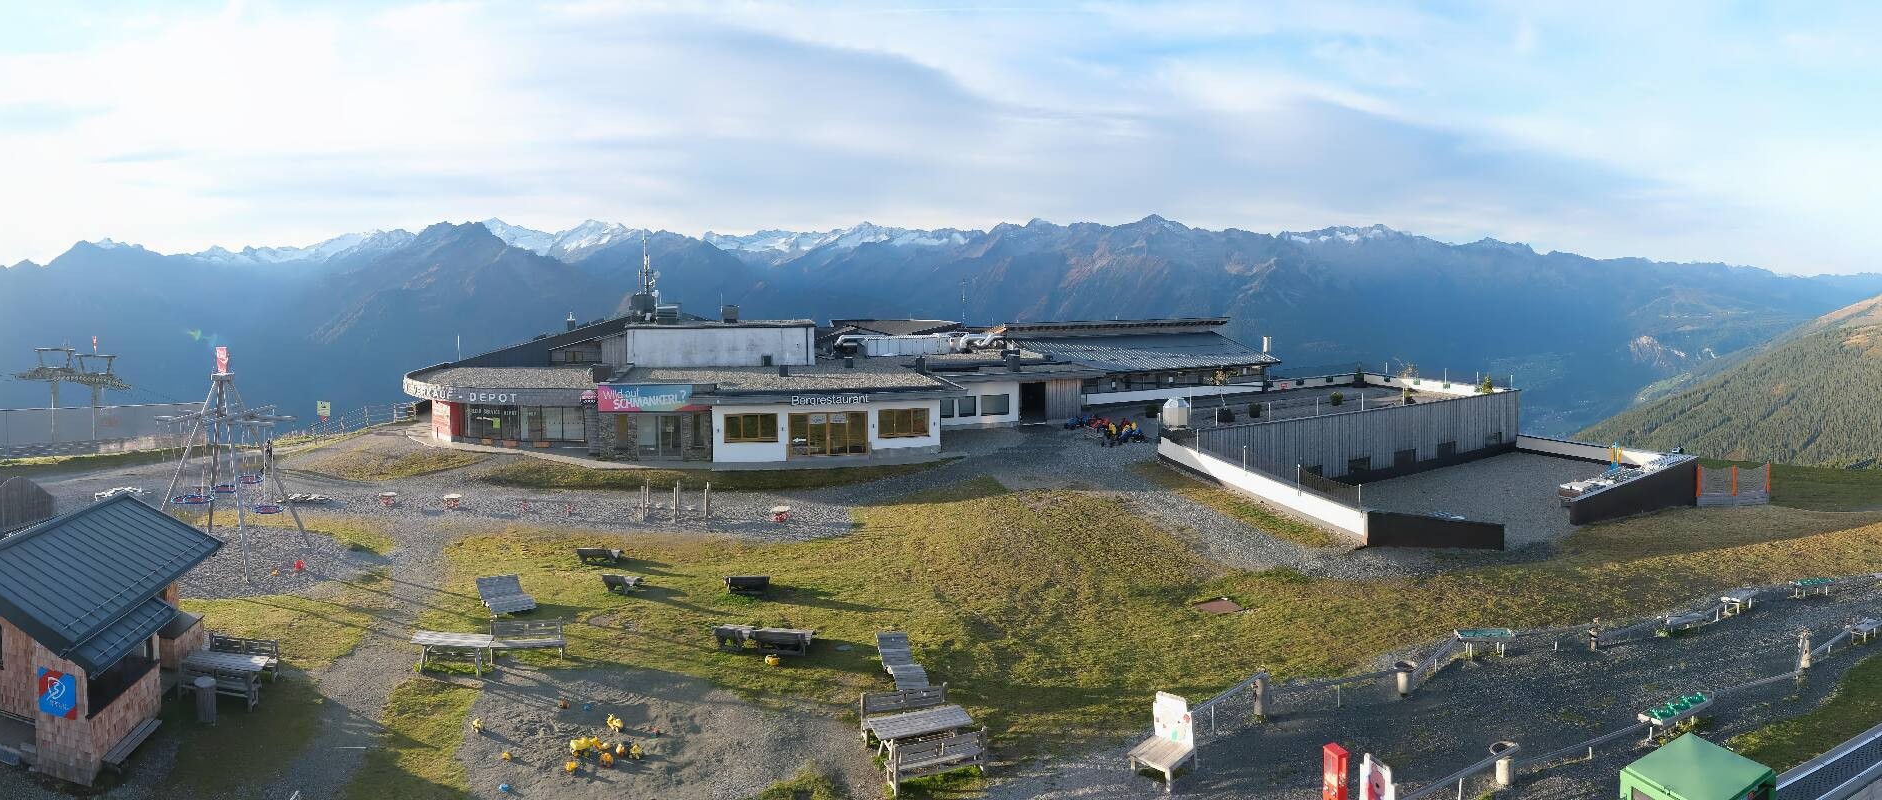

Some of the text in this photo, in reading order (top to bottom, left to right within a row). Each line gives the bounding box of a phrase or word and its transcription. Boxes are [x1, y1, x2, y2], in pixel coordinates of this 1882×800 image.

[469, 393, 518, 403] DEPOT
[603, 388, 640, 400] Wild auf
[613, 390, 687, 410] SCHMANKERL?
[791, 394, 870, 406] Bergrestaurant
